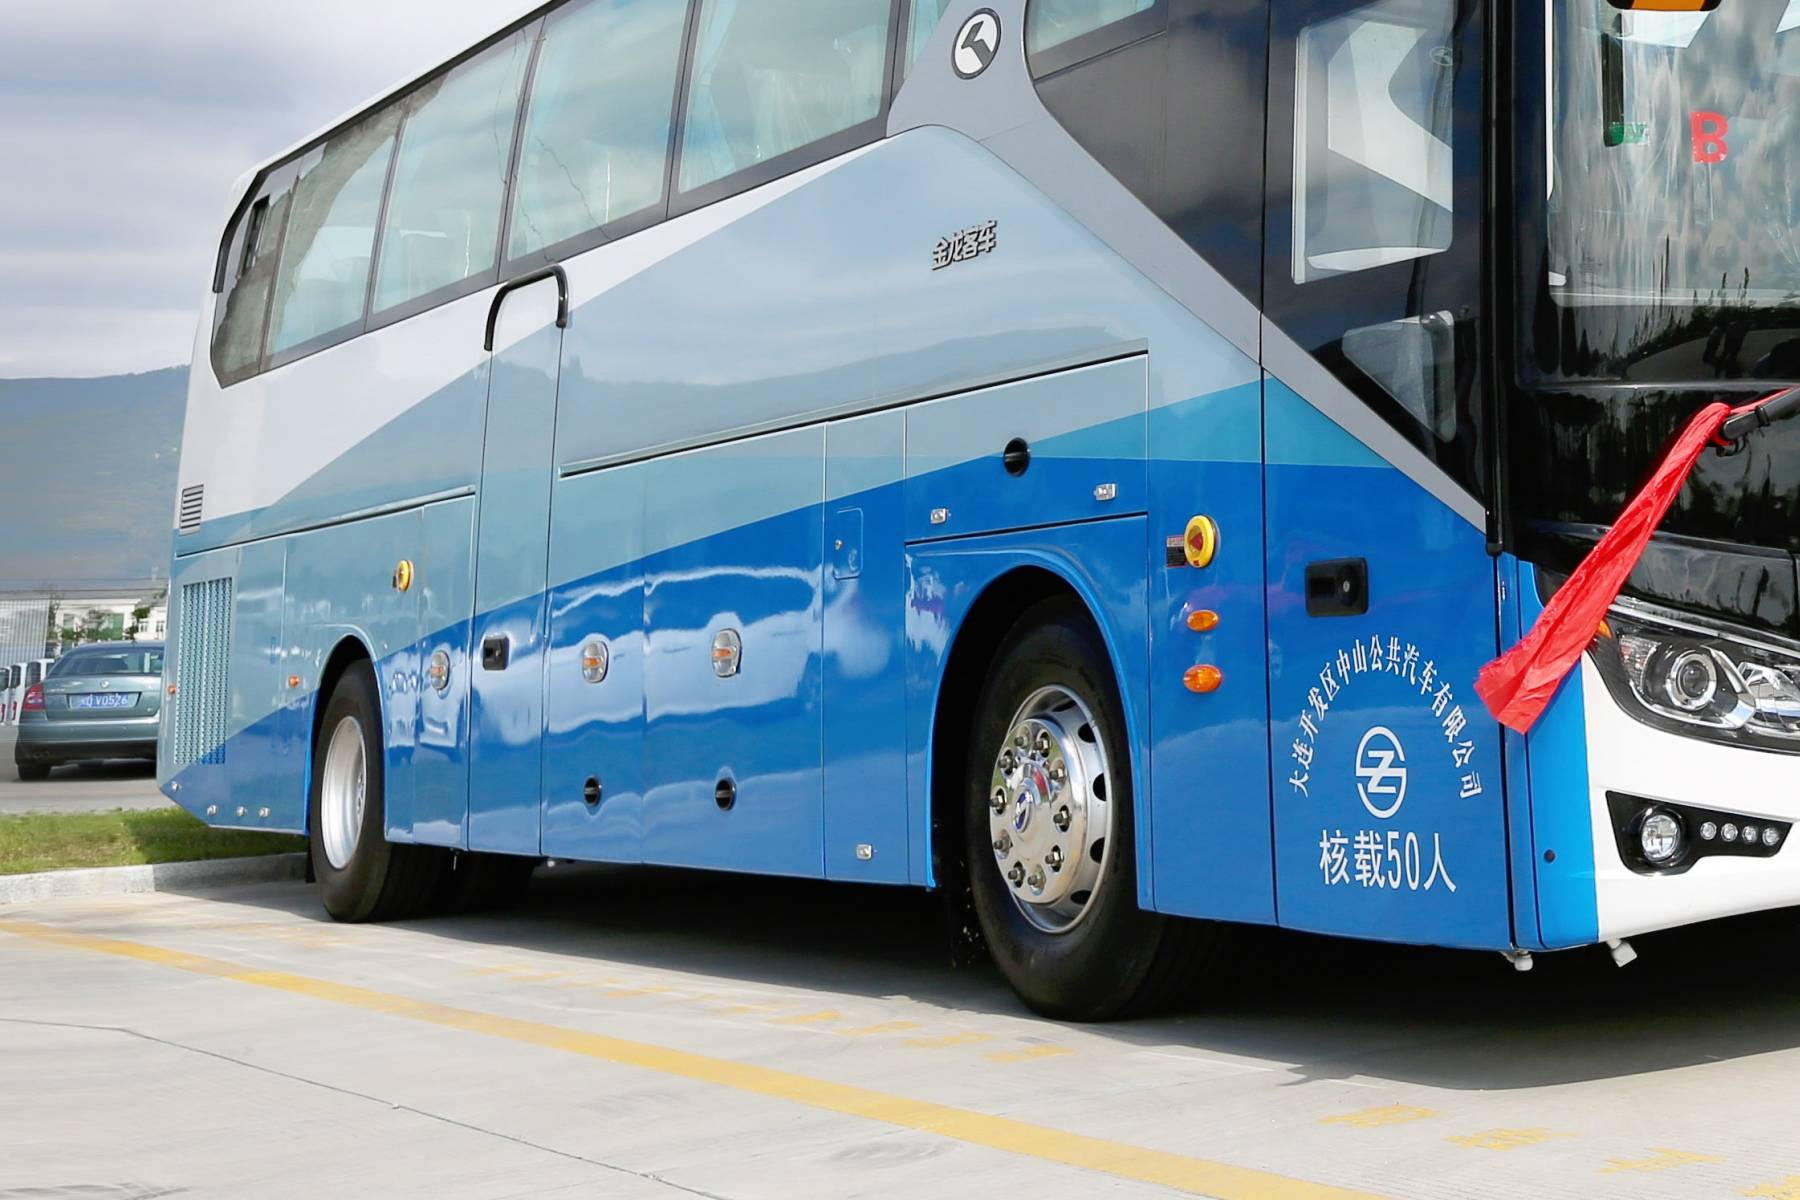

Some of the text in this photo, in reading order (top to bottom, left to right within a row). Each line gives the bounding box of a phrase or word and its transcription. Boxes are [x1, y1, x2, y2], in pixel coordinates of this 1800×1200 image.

[1690, 111, 1729, 164] B
[1288, 634, 1483, 799] 大连开发区中山公共汽车有限公司
[1319, 829, 1456, 892] 核载50人
